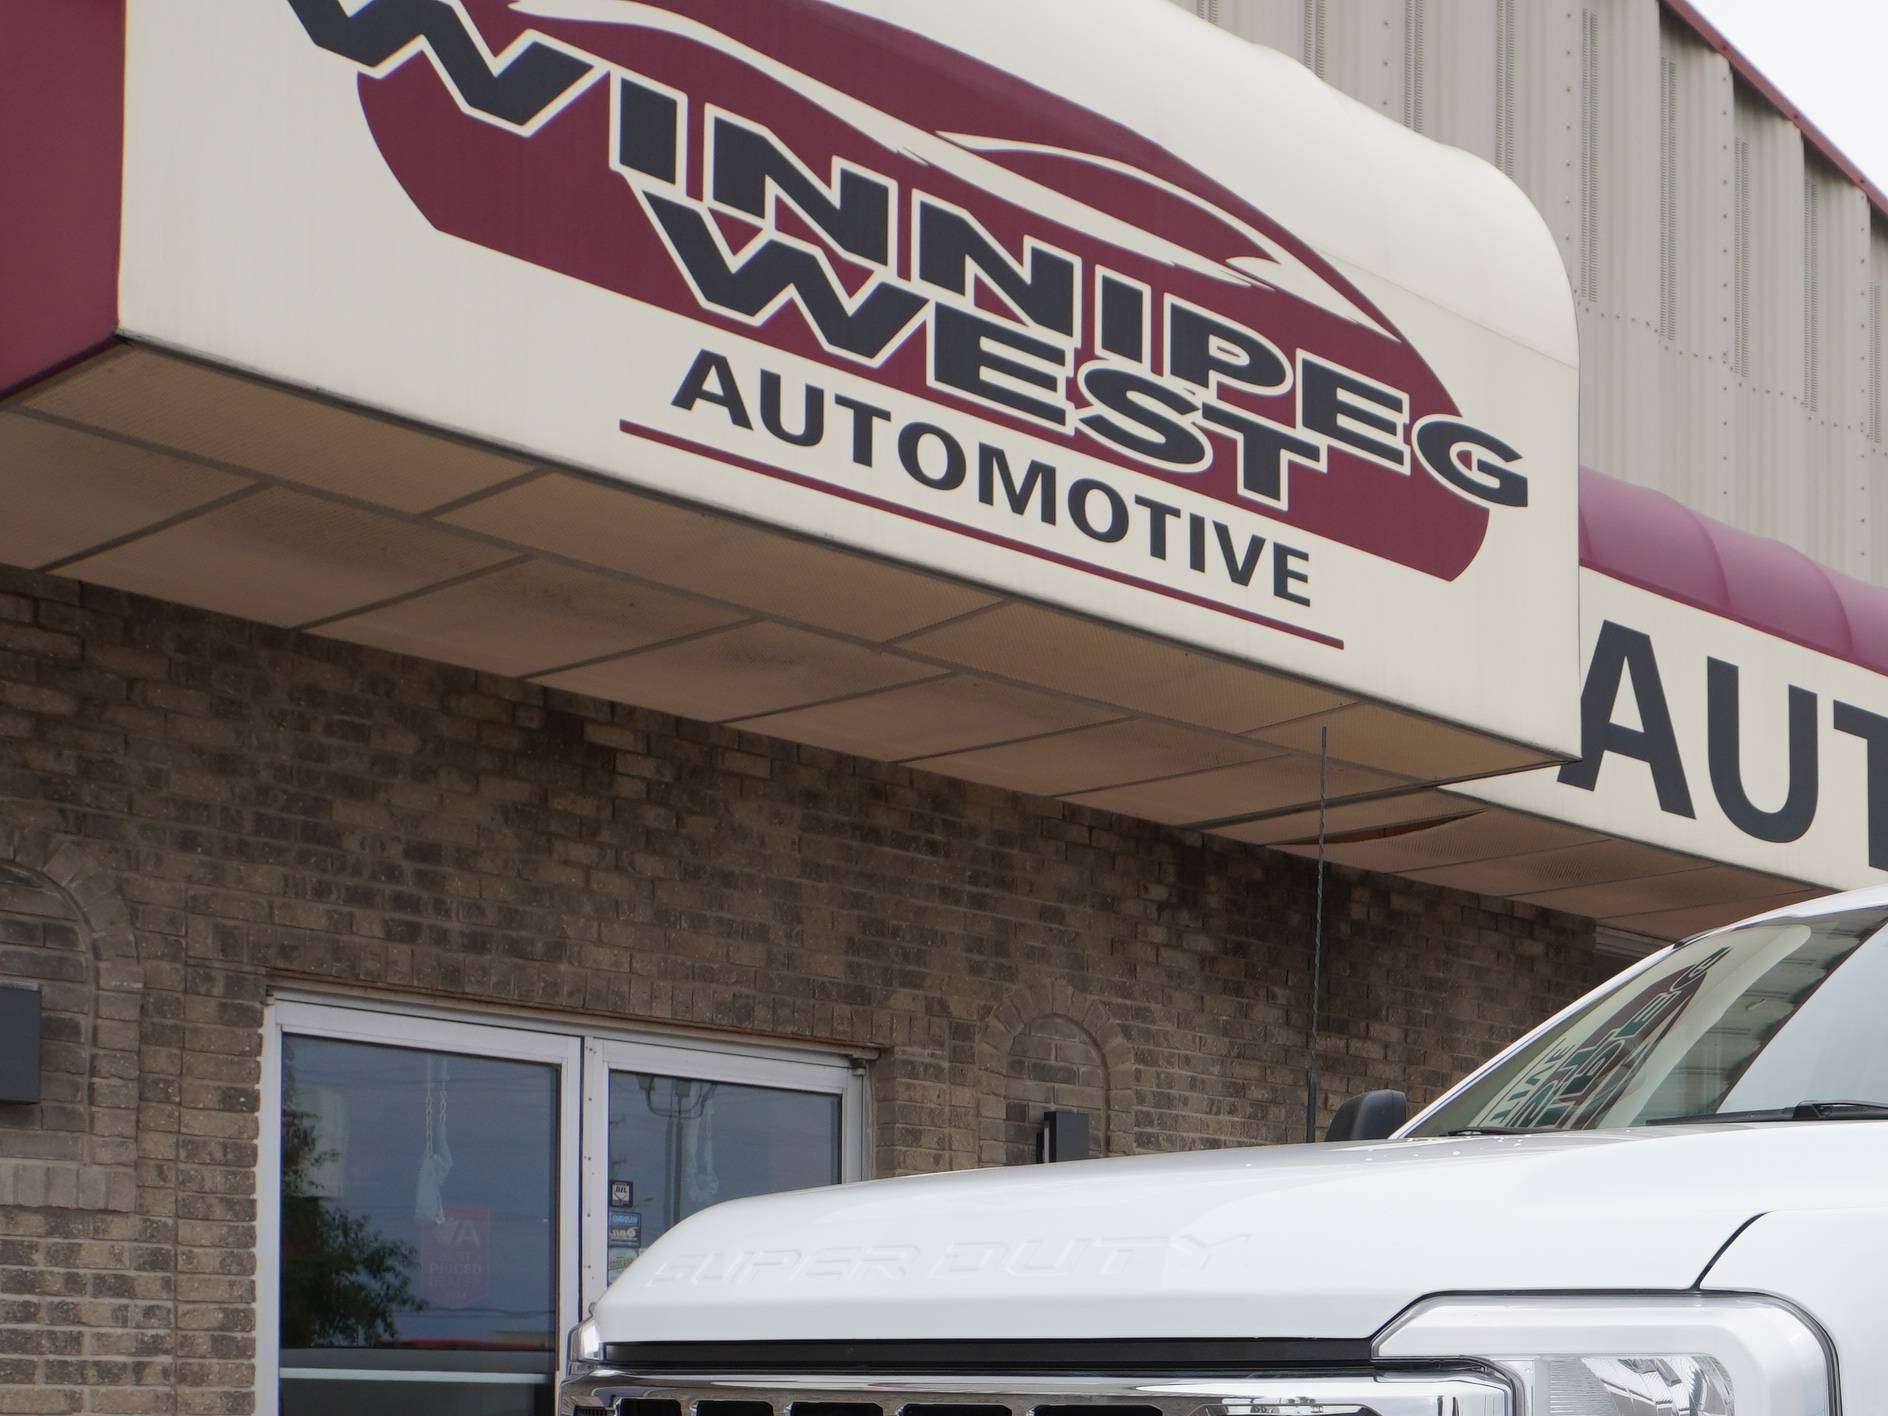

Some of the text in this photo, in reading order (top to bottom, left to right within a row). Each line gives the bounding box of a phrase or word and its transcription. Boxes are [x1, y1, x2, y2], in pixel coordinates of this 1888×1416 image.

[288, 0, 1528, 508] WINNIPEG
[643, 190, 1320, 502] WEST
[671, 349, 1311, 608] AUTOMOTIVE
[646, 1244, 922, 1287] SUPER
[926, 1233, 1254, 1281] DUTY
